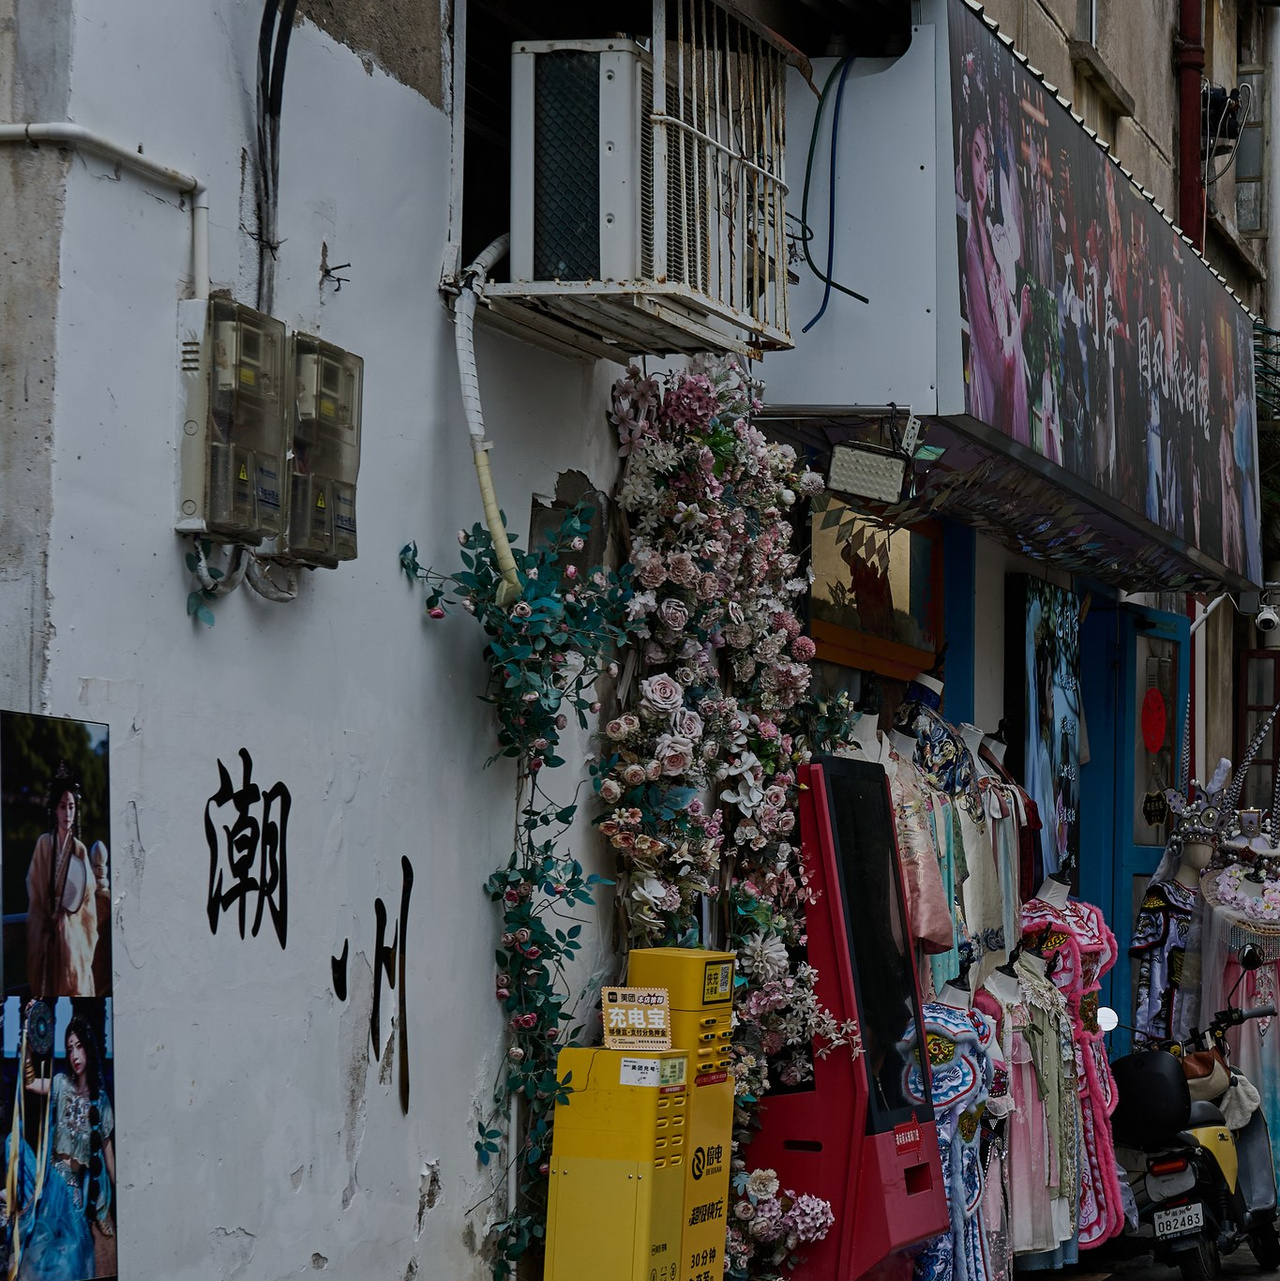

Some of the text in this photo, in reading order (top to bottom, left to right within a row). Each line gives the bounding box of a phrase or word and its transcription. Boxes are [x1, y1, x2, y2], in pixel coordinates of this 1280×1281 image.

[608, 1007, 666, 1028] 充电宝
[706, 1144, 723, 1166] 倍电
[689, 1197, 724, 1226] 超级快充
[1158, 1213, 1201, 1233] 082483
[691, 1247, 716, 1269] 30分钟
